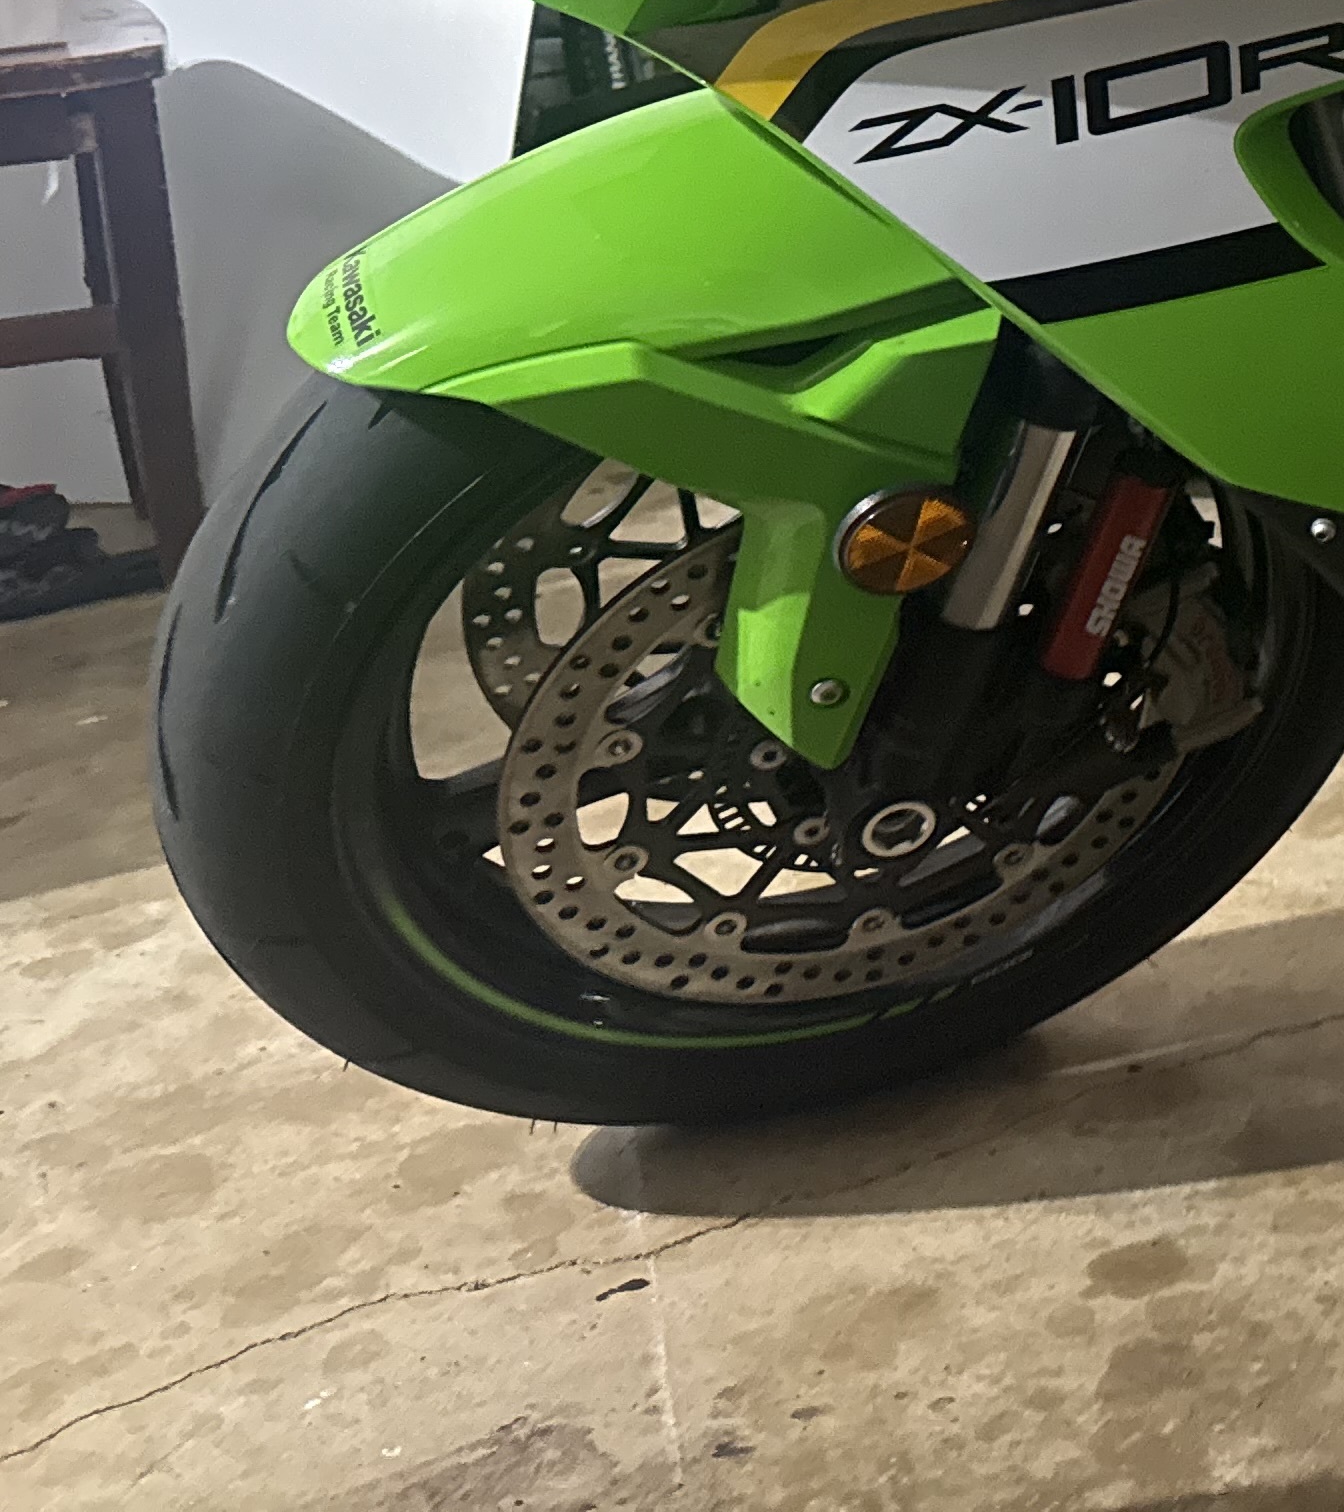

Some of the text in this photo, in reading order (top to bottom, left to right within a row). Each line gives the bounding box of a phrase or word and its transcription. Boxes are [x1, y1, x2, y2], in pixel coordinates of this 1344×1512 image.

[327, 305, 345, 346] Team
[341, 245, 382, 348] Kawasaki
[1084, 533, 1148, 638] SHOWA
